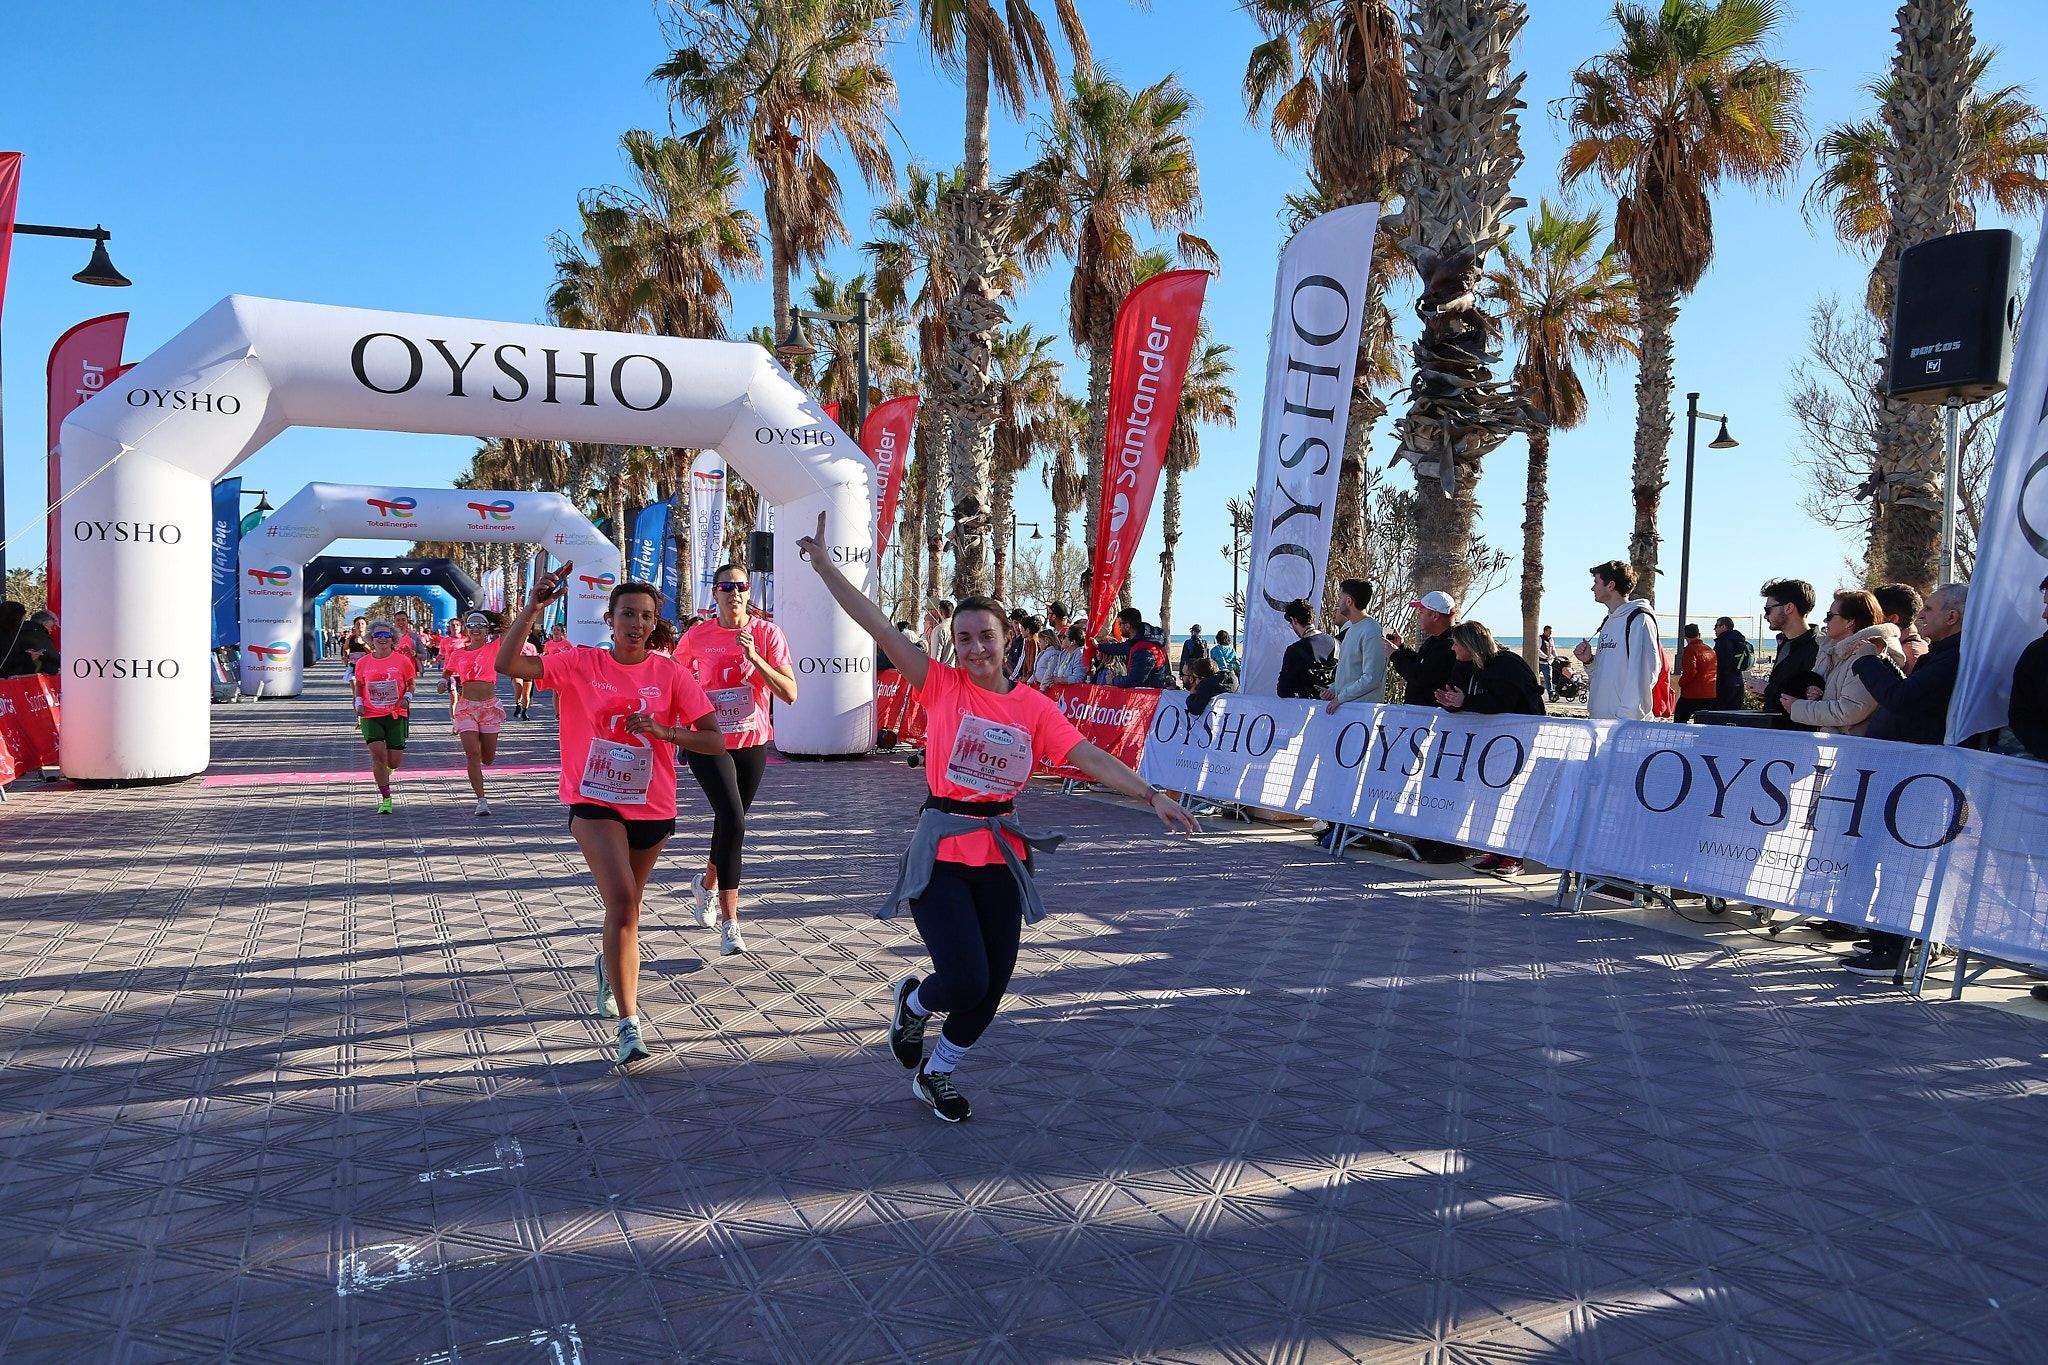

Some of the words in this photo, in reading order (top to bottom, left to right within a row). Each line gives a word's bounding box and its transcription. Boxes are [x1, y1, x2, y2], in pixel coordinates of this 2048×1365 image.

[350, 333, 673, 411] OYSHO
[127, 388, 240, 415] OYSHO
[1117, 315, 1172, 488] Santander
[755, 427, 836, 447] OYSHO
[1263, 275, 1350, 613] OYSHO
[74, 521, 181, 544] OYSHO
[367, 521, 418, 529] TotalEnergies
[799, 546, 871, 563] OSHO
[340, 566, 431, 576] VOLVO
[73, 658, 179, 679] OYSHO
[799, 657, 871, 674] OYSHO
[592, 680, 618, 693] OYSHO
[722, 708, 740, 716] 016
[1067, 697, 1139, 727] Santander
[1155, 705, 1275, 757] OYSHO
[979, 753, 1008, 769] 016
[1336, 722, 1524, 789] OYSHO
[608, 769, 631, 782] 016
[954, 774, 977, 786] OYSHO
[1634, 750, 1969, 849] OYSHO
[1700, 840, 1849, 877] WWW.OYSHO.COM
